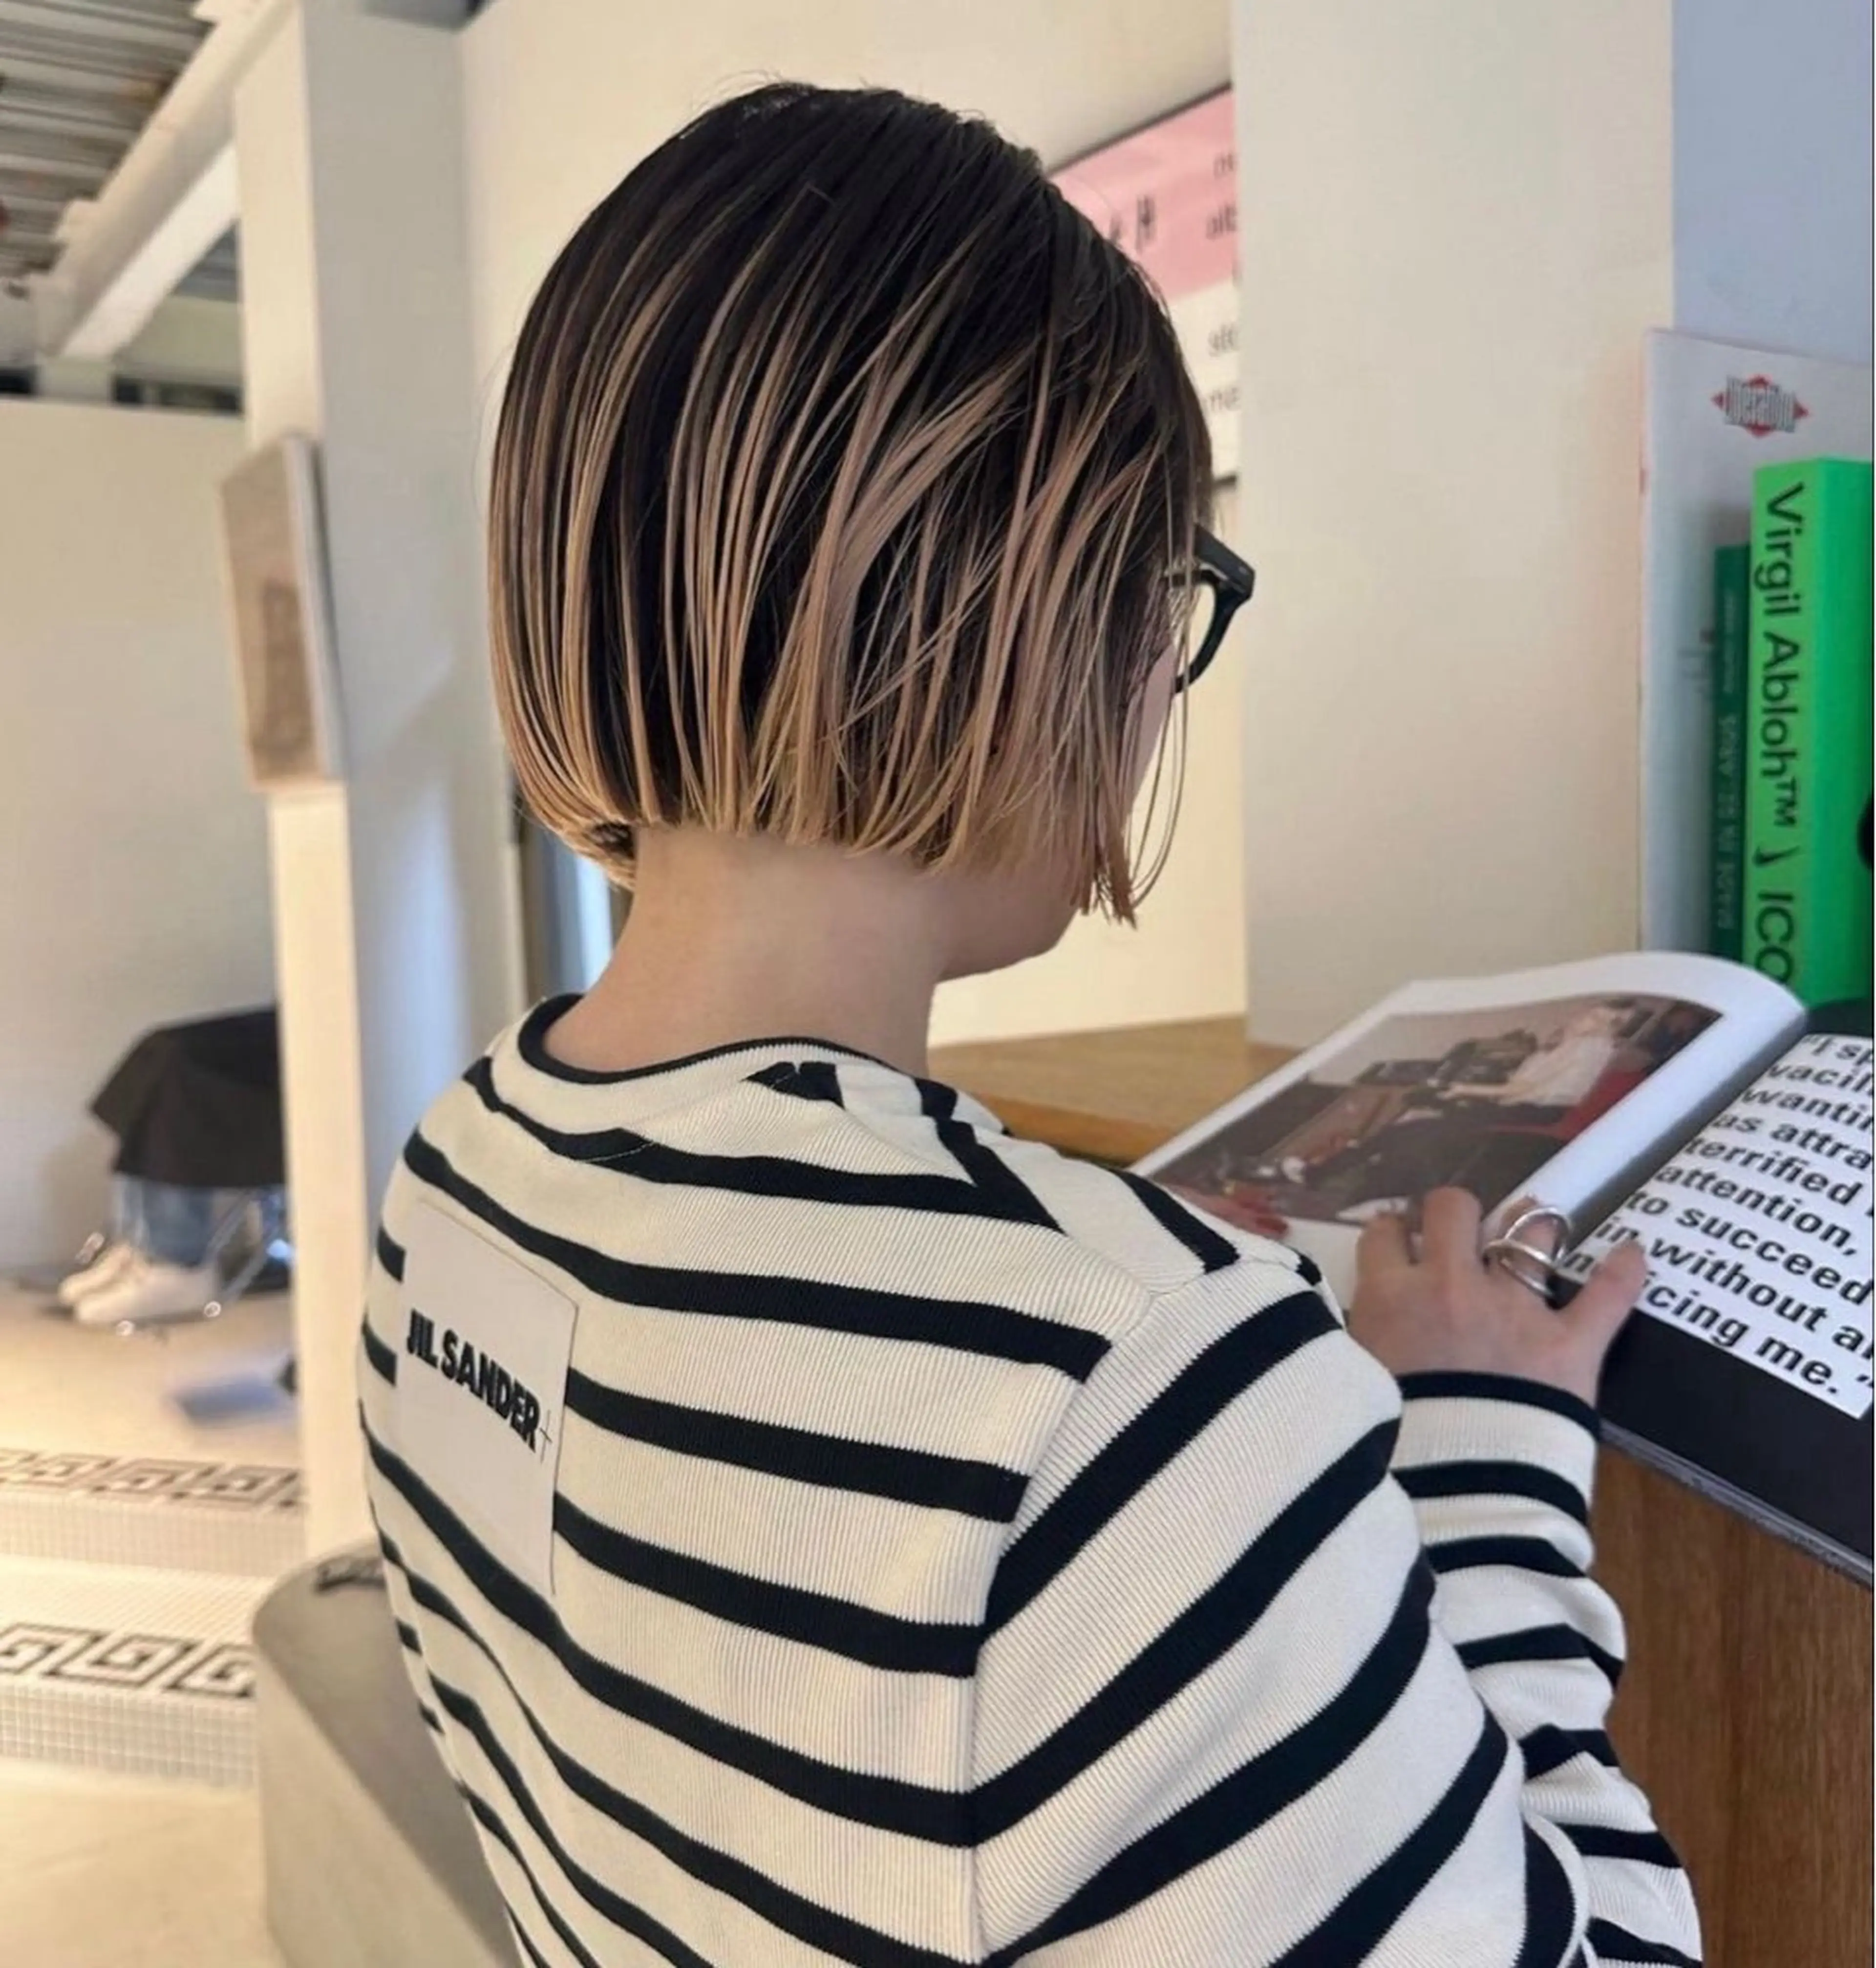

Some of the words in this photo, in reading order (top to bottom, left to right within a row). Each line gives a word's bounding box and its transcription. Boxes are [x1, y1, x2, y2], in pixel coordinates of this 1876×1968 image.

[1754, 481, 1804, 617] Virgil
[1767, 1064, 1872, 1097] vacil
[1711, 1113, 1764, 1133] as
[1654, 1165, 1857, 1256] attention,
[1684, 1137, 1863, 1206] terrified
[1626, 1190, 1670, 1215] to
[1675, 1208, 1872, 1305] succeed
[1649, 1237, 1827, 1332] without
[407, 1307, 438, 1369] JIL
